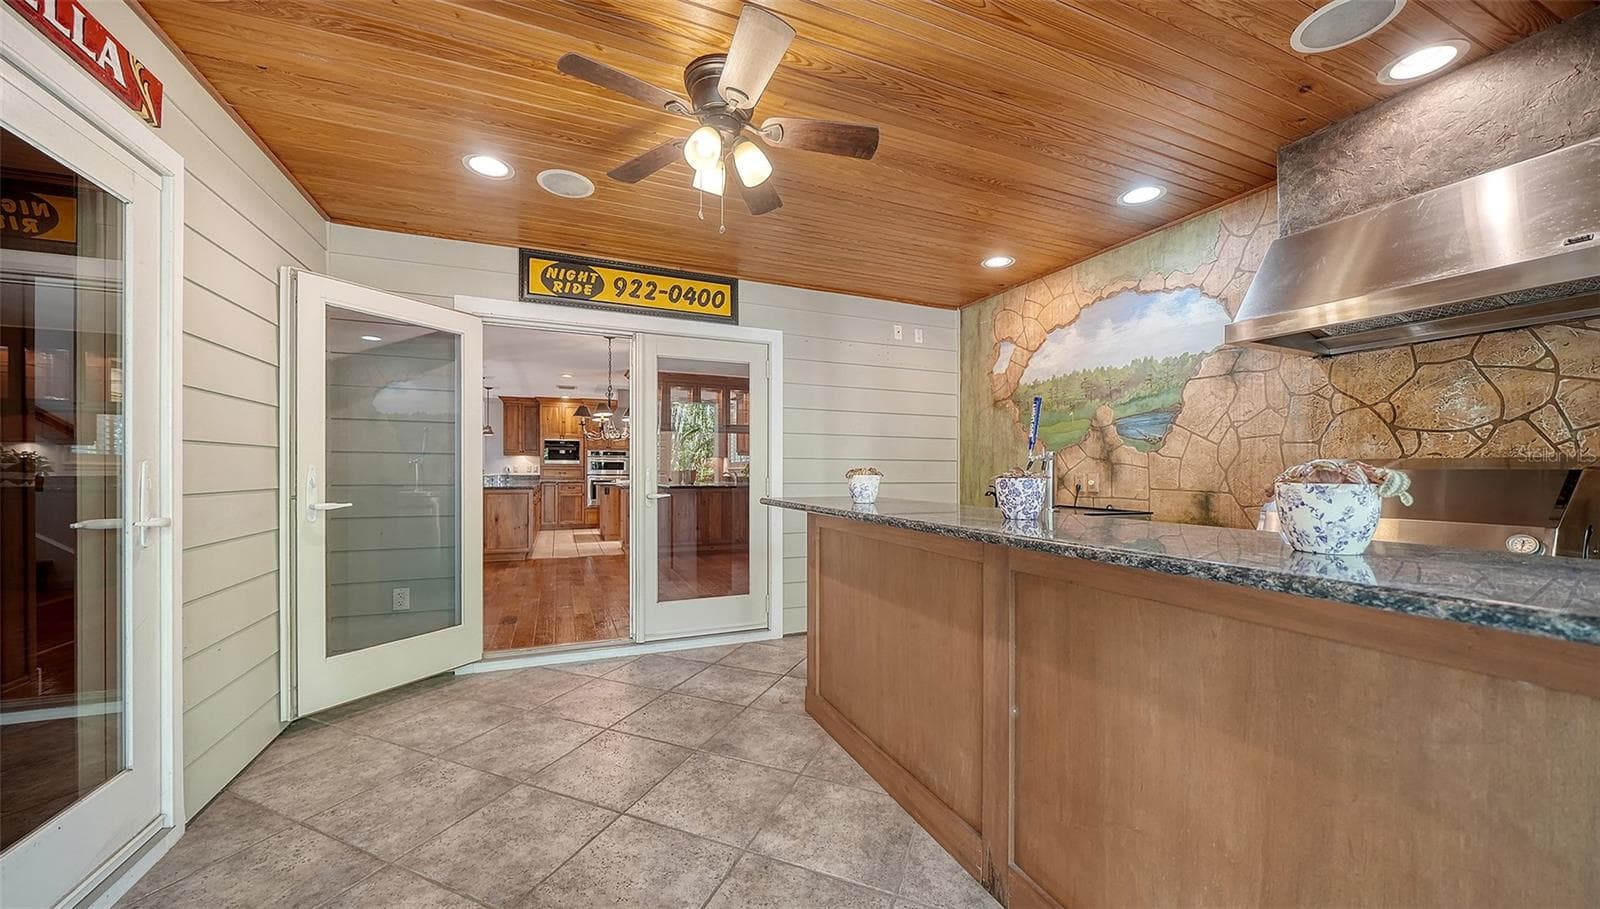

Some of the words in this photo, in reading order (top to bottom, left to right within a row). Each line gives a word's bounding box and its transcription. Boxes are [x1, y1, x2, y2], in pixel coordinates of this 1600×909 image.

[25, 0, 127, 88] LLA
[546, 266, 598, 283] NIGHT
[552, 280, 593, 296] RIDE
[613, 276, 726, 309] 922-0400
